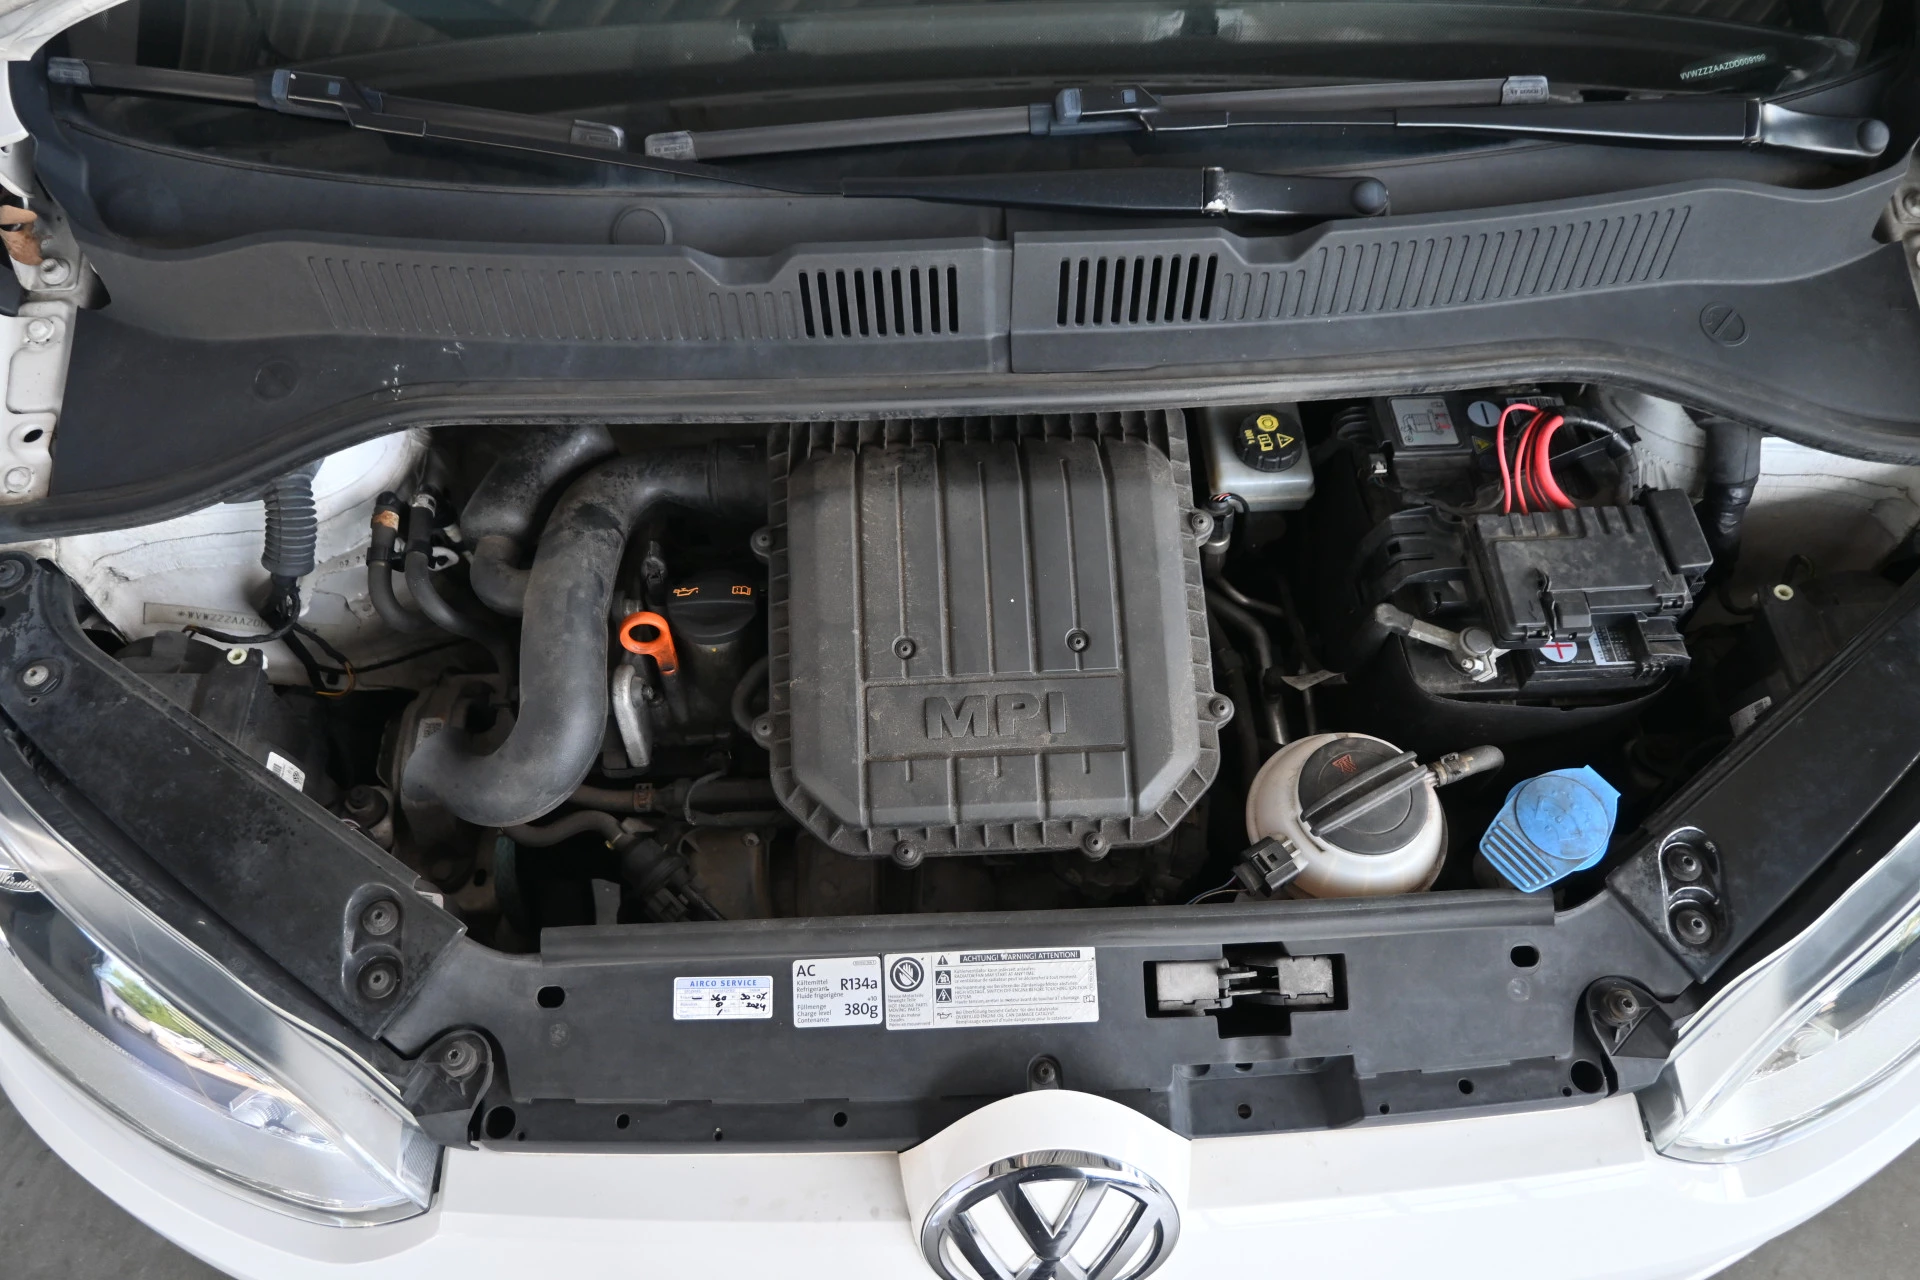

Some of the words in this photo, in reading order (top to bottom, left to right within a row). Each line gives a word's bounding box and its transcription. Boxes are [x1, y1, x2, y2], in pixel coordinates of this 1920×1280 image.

[924, 692, 1066, 739] MPI
[797, 964, 816, 977] AC
[841, 978, 878, 990] R134a
[845, 1003, 878, 1018] 380g
